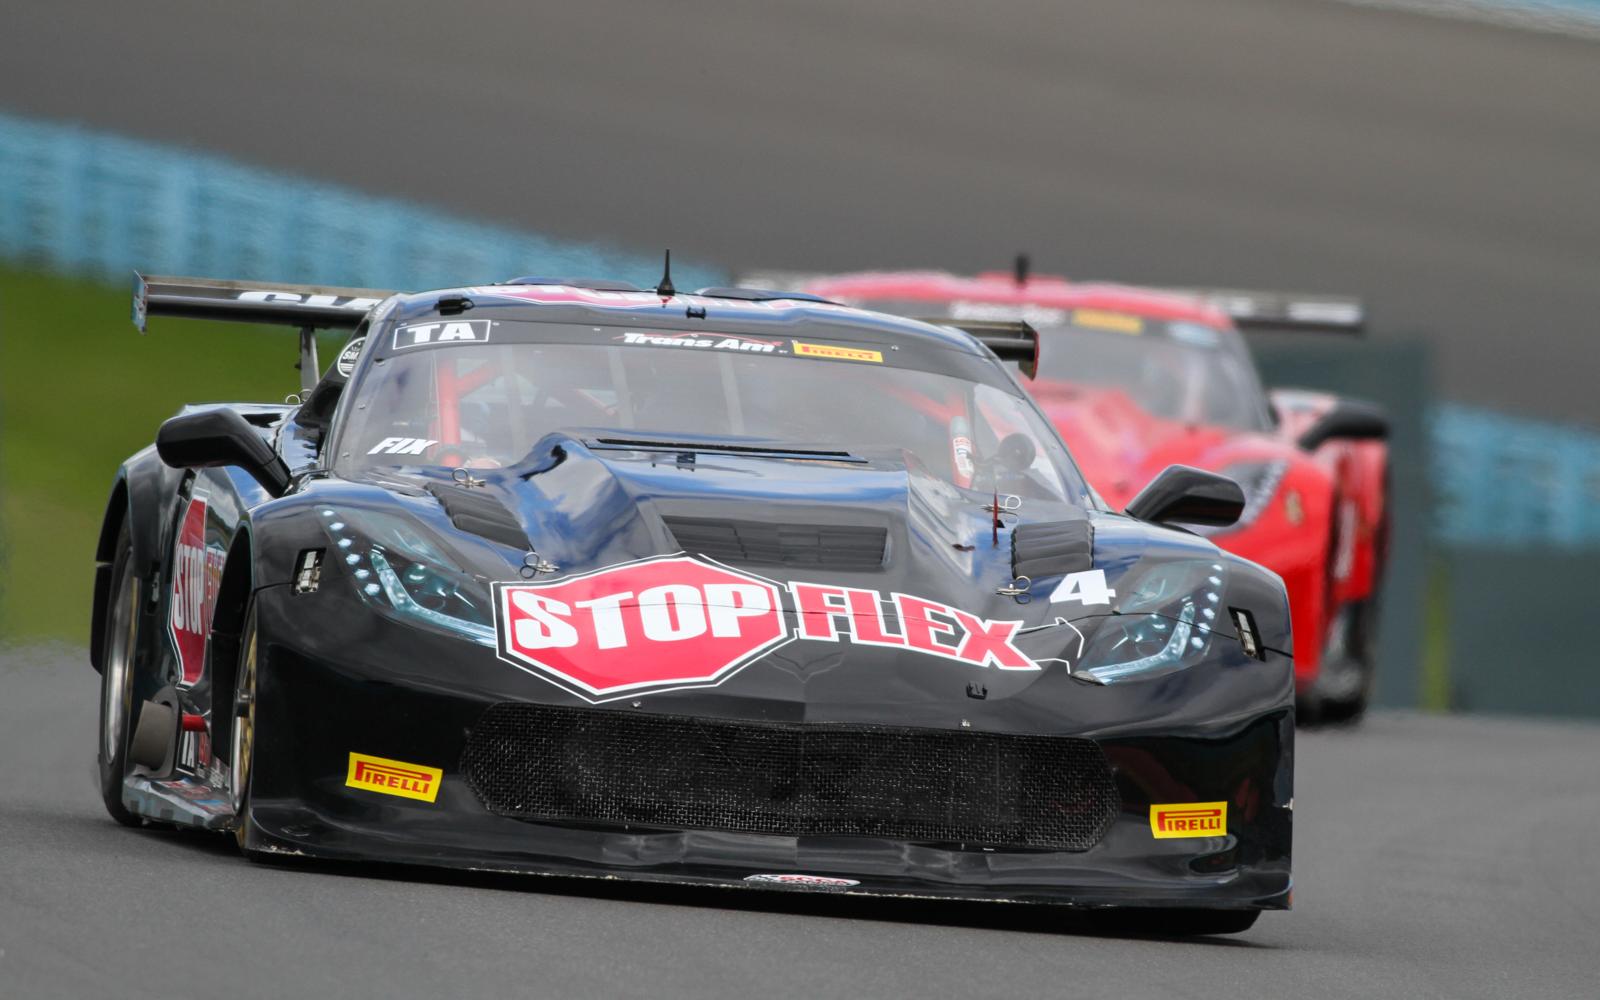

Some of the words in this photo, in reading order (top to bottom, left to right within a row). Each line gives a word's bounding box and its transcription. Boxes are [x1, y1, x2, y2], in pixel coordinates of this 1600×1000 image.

[407, 323, 476, 343] TA
[623, 333, 713, 348] Trans
[714, 338, 775, 352] Am
[367, 437, 439, 455] FIX
[174, 543, 204, 635] STOP
[1049, 569, 1116, 605] 4
[511, 584, 770, 650] STOP
[788, 581, 1042, 671] FLEX
[355, 760, 433, 794] PIRELLI
[1157, 809, 1222, 832] PIRELLI
